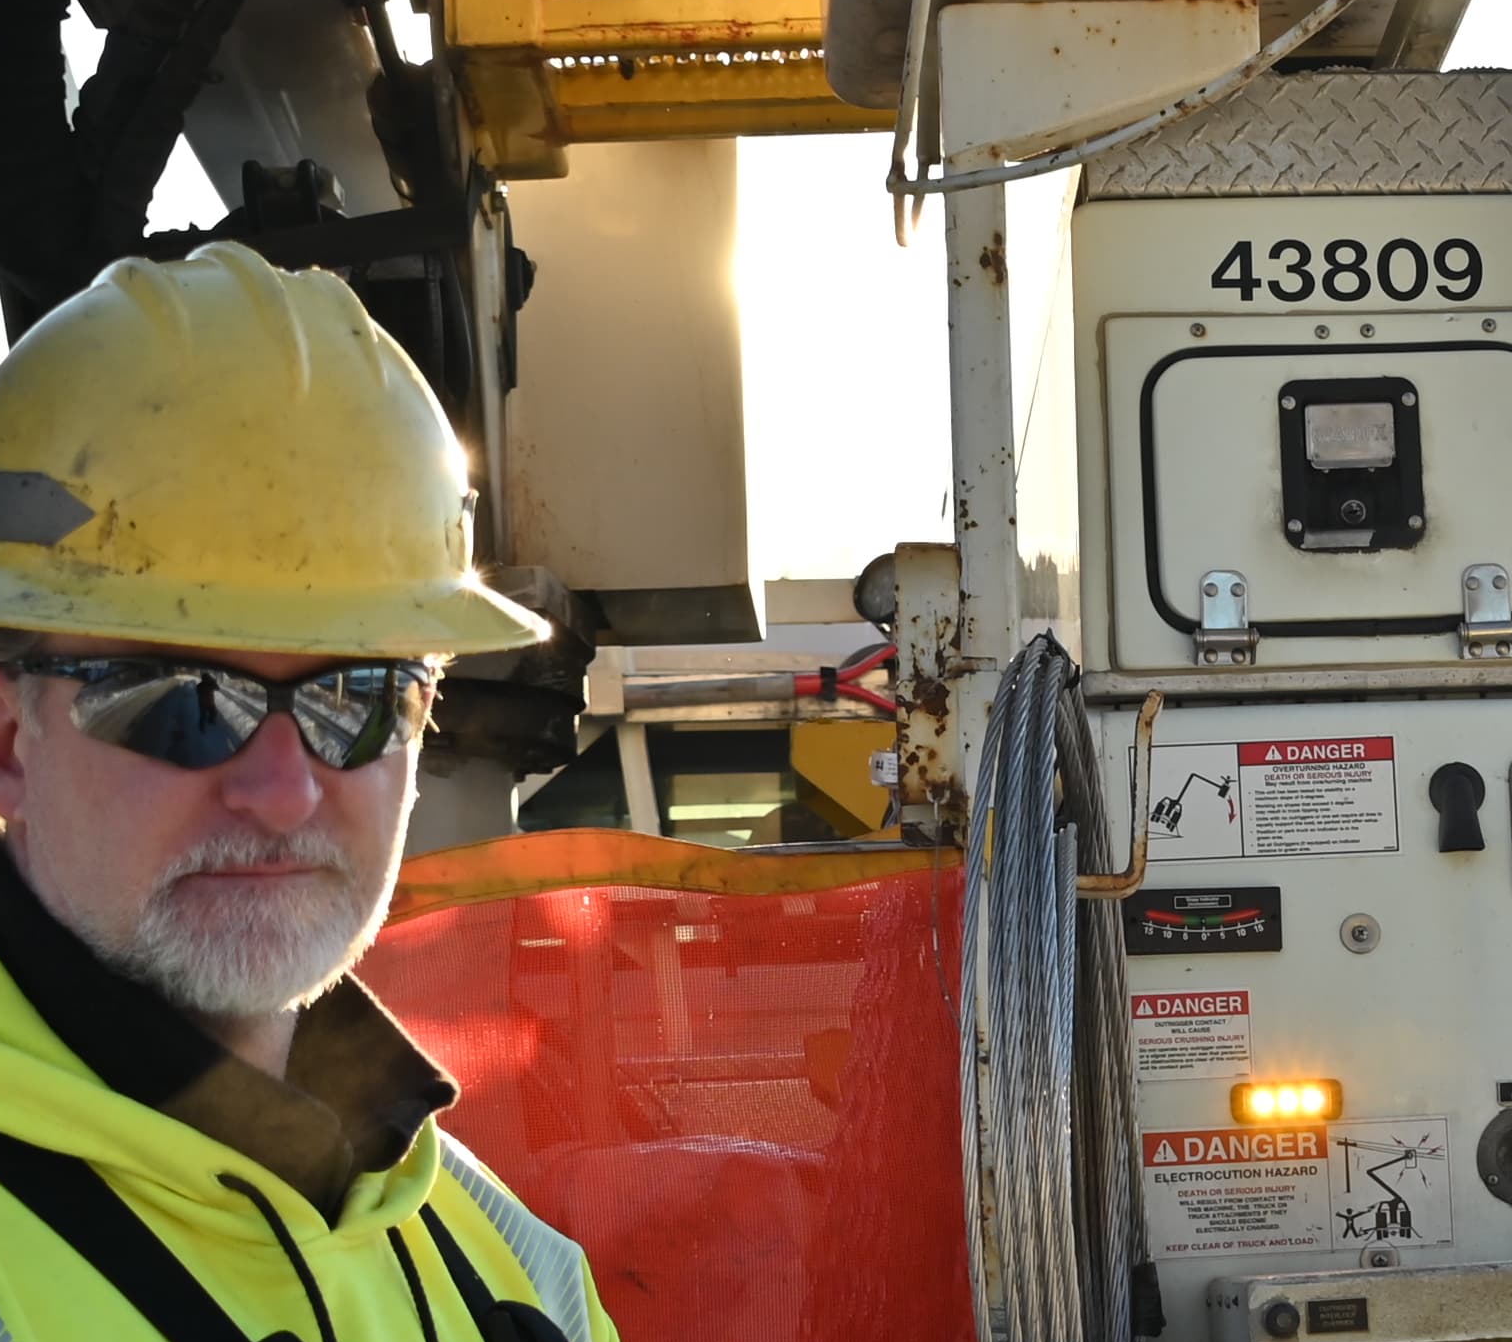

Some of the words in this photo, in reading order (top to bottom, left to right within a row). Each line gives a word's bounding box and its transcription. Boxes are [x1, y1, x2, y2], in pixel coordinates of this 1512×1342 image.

[1210, 238, 1484, 301] 43809
[1287, 743, 1365, 759] DANGER
[1272, 764, 1330, 773] OVERTURNING
[1332, 762, 1365, 770] HAZARD
[1264, 773, 1291, 781] DEATH
[1293, 772, 1305, 780] OR
[1306, 771, 1342, 780] SERIOUS
[1343, 770, 1372, 778] INJURY
[1144, 927, 1154, 935] 15
[1162, 930, 1172, 938] 10
[1220, 931, 1226, 939] 5
[1236, 929, 1247, 937] 10
[1254, 924, 1264, 933] 15
[1157, 996, 1242, 1015] DANGER
[1138, 1037, 1172, 1045] SERIOUS
[1174, 1036, 1215, 1044] CRUSHING
[1184, 1132, 1317, 1162] DANGER
[1154, 1169, 1261, 1184] ELECTROCUTION
[1265, 1165, 1317, 1178] HAZARD
[1178, 1189, 1207, 1197] DEATH
[1209, 1188, 1222, 1196] OR
[1224, 1186, 1263, 1195] SERIOUS
[1265, 1185, 1296, 1194] INJURY
[1211, 1211, 1261, 1219] ATTACHMENTS
[1165, 1244, 1189, 1252] KEEP
[1191, 1242, 1221, 1251] CLEAR
[1223, 1241, 1234, 1249] OF
[1237, 1240, 1266, 1249] TRUCK
[1269, 1238, 1289, 1247] AND
[1289, 1237, 1314, 1246] LOAD
